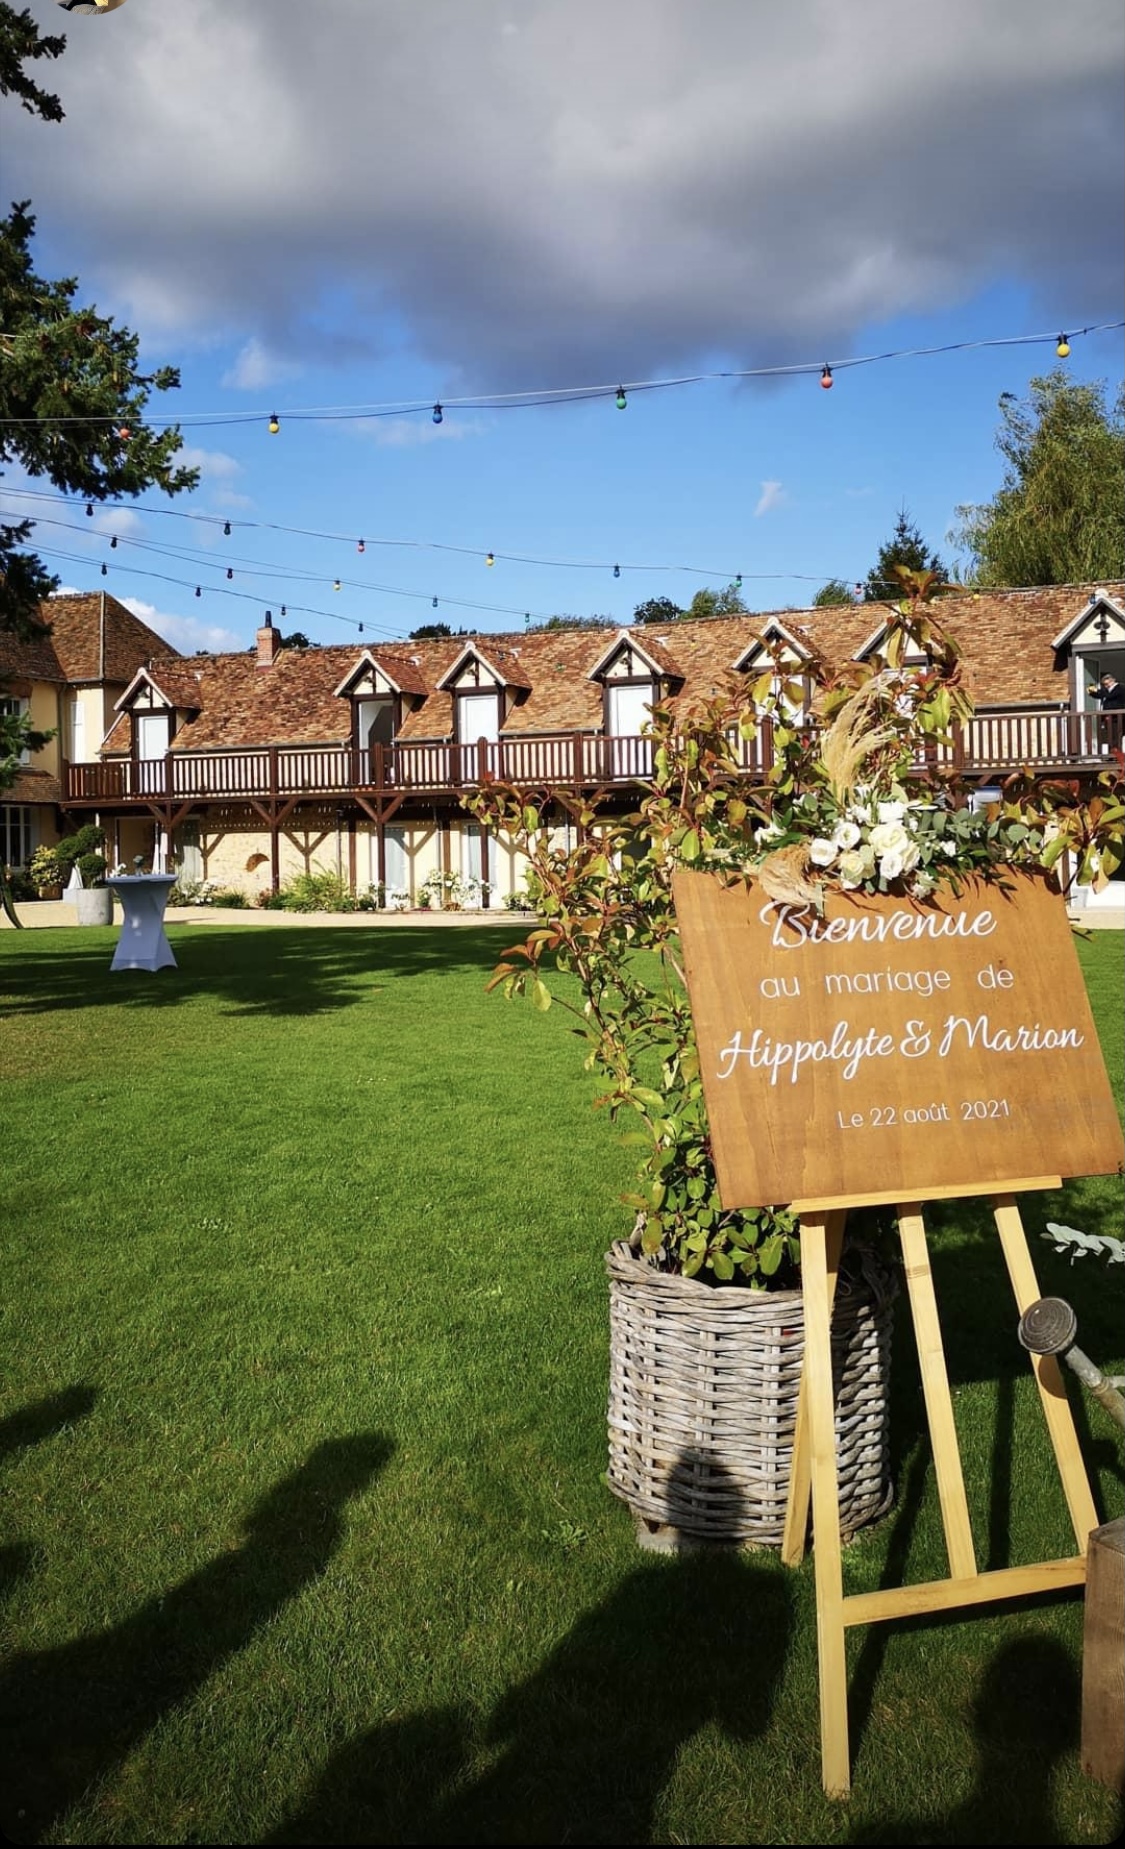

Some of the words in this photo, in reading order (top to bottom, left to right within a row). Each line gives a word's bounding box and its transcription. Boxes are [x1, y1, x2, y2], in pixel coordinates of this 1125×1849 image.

[759, 900, 997, 949] Bienvenue
[759, 974, 801, 999] au
[825, 966, 952, 997] mariage
[977, 964, 1015, 989] de
[716, 1021, 895, 1086] Hippolyte
[900, 1020, 932, 1058] &
[938, 1014, 1085, 1057] Marion
[837, 1109, 863, 1129] Le
[870, 1106, 897, 1127] 22
[904, 1102, 951, 1124] août
[961, 1099, 1011, 1122] 2021
